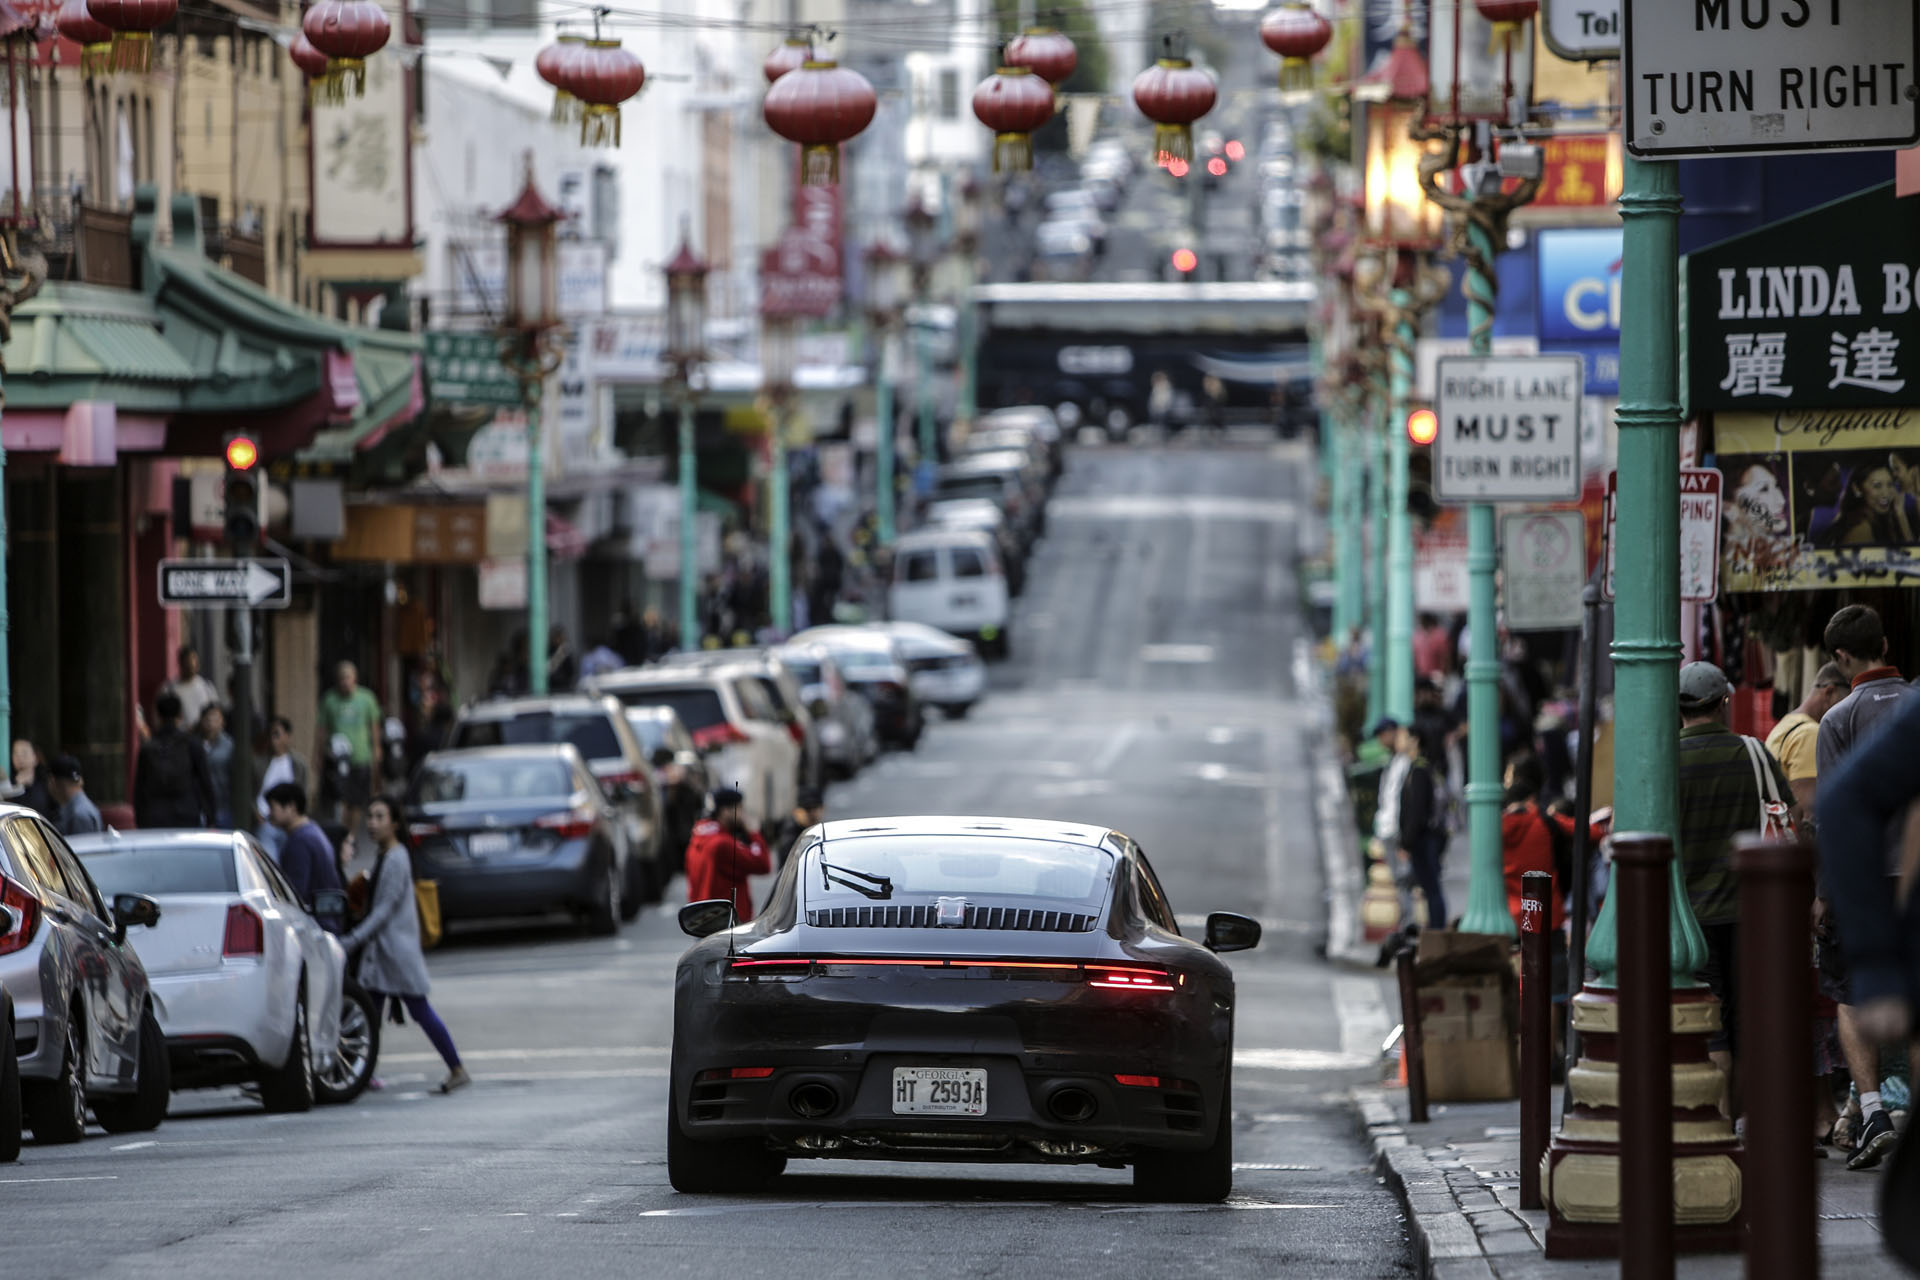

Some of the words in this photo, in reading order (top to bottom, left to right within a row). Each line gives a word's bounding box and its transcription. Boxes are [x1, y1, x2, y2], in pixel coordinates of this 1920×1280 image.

[1695, 0, 1840, 31] MUST
[1642, 69, 1753, 115] TURN
[1780, 63, 1905, 110] RIGHT
[1718, 264, 1862, 319] LINDA
[1882, 263, 1920, 314] B
[1445, 376, 1505, 399] RIGHT
[1513, 376, 1572, 399] LANE
[1454, 414, 1561, 442] MUST
[1774, 408, 1912, 446] Original
[1445, 456, 1500, 480] TURN
[1510, 456, 1571, 480] RIGHT
[171, 572, 205, 594] ONE
[214, 571, 248, 594] WAY
[916, 1070, 966, 1080] GEORGIA
[897, 1080, 917, 1102] HT
[930, 1080, 982, 1104] 2593A
